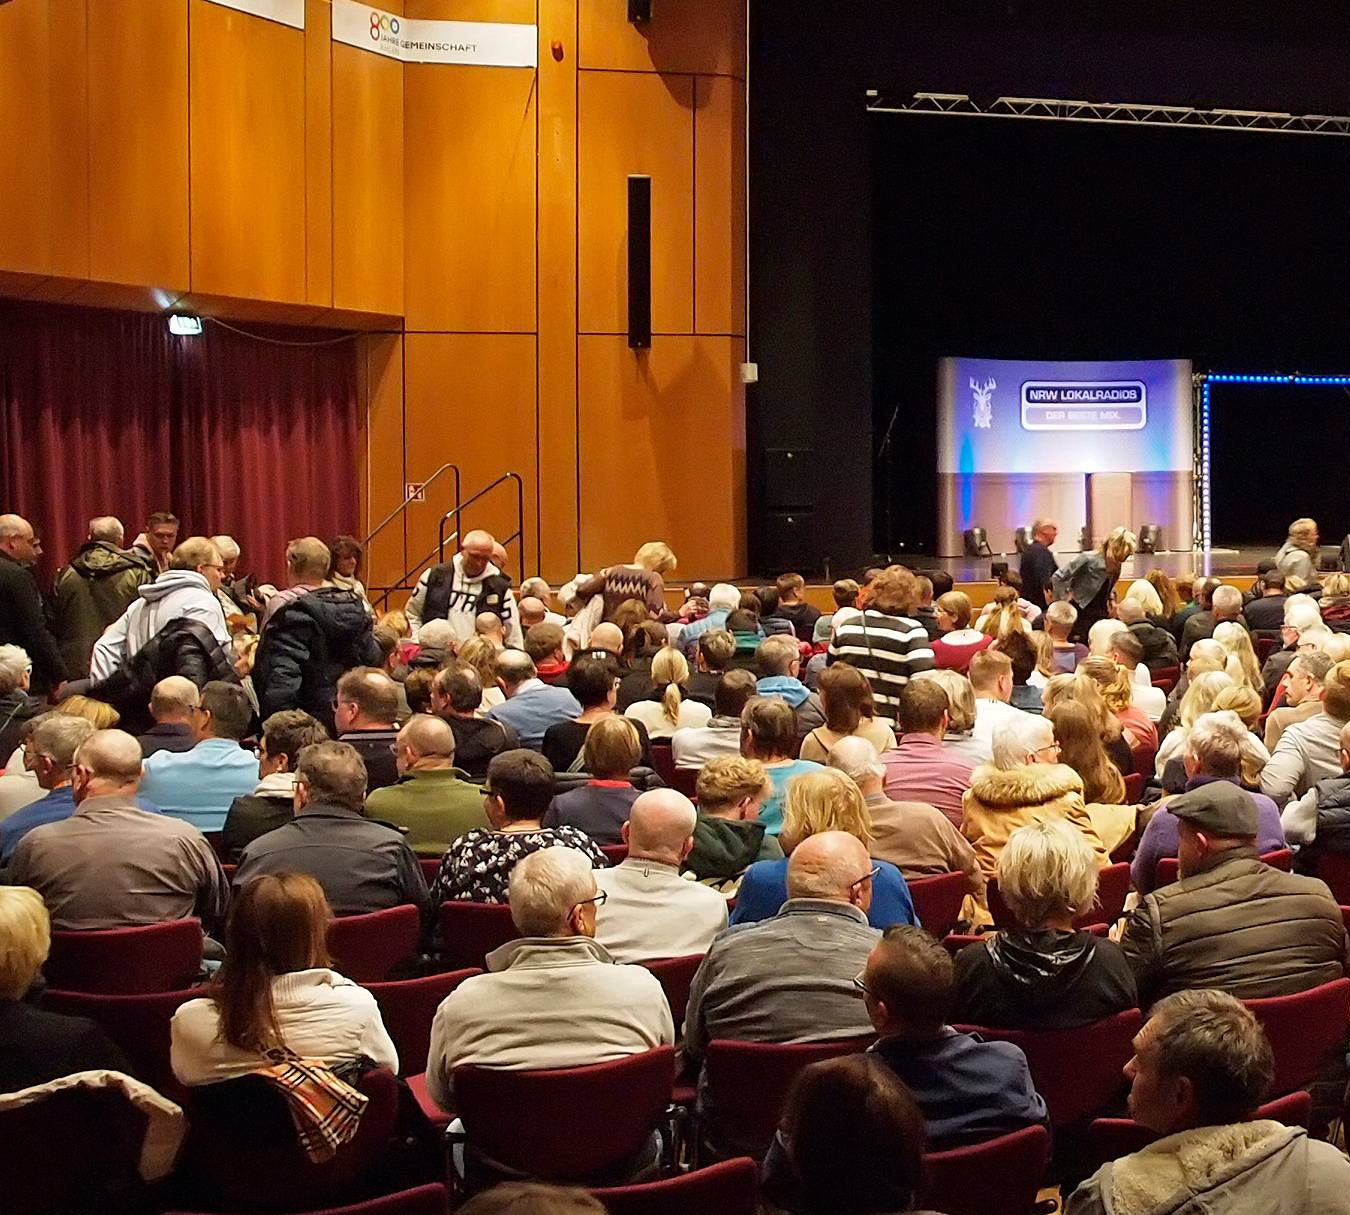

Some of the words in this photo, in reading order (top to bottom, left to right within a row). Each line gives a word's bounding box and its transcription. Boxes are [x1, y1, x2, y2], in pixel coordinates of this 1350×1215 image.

[381, 35, 399, 46] JAHRE
[400, 40, 477, 52] GEMEINSCHAFT
[1030, 389, 1058, 400] NRW
[1061, 389, 1137, 400] LOKALRADIOS
[1046, 411, 1065, 420] DER
